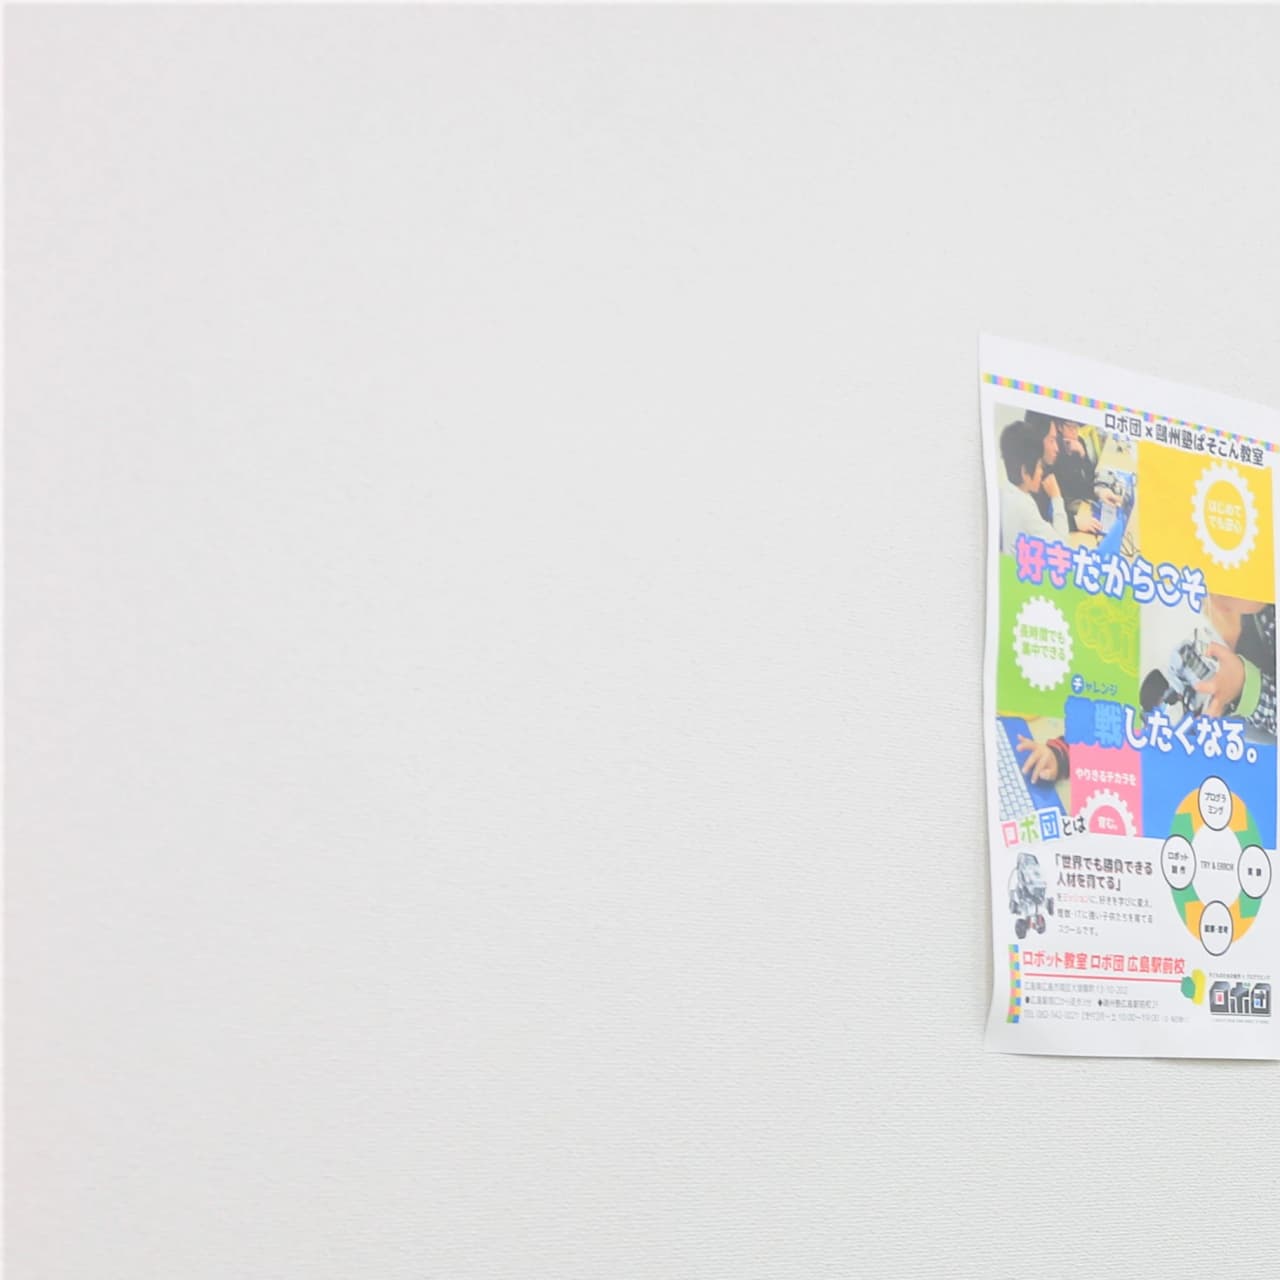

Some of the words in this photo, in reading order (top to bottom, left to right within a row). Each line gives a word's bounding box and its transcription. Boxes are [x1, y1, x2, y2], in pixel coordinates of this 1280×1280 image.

[1104, 413, 1142, 438] ロボ団
[1207, 499, 1242, 519] はじめて
[1015, 532, 1208, 612] 好きだからこそ
[1065, 696, 1258, 764] 戦したくなる。
[1075, 767, 1138, 786] やりきるチカラを
[1203, 791, 1227, 804] プログラ
[1207, 805, 1224, 816] ミング
[1001, 807, 1087, 848] ロボ団とは
[1167, 851, 1190, 863] ロボット
[1056, 873, 1122, 892] 人材を育てる」
[1022, 949, 1088, 971] ロボット教室
[1090, 954, 1125, 973] ロボ団
[1126, 955, 1186, 976] 広島駅前校
